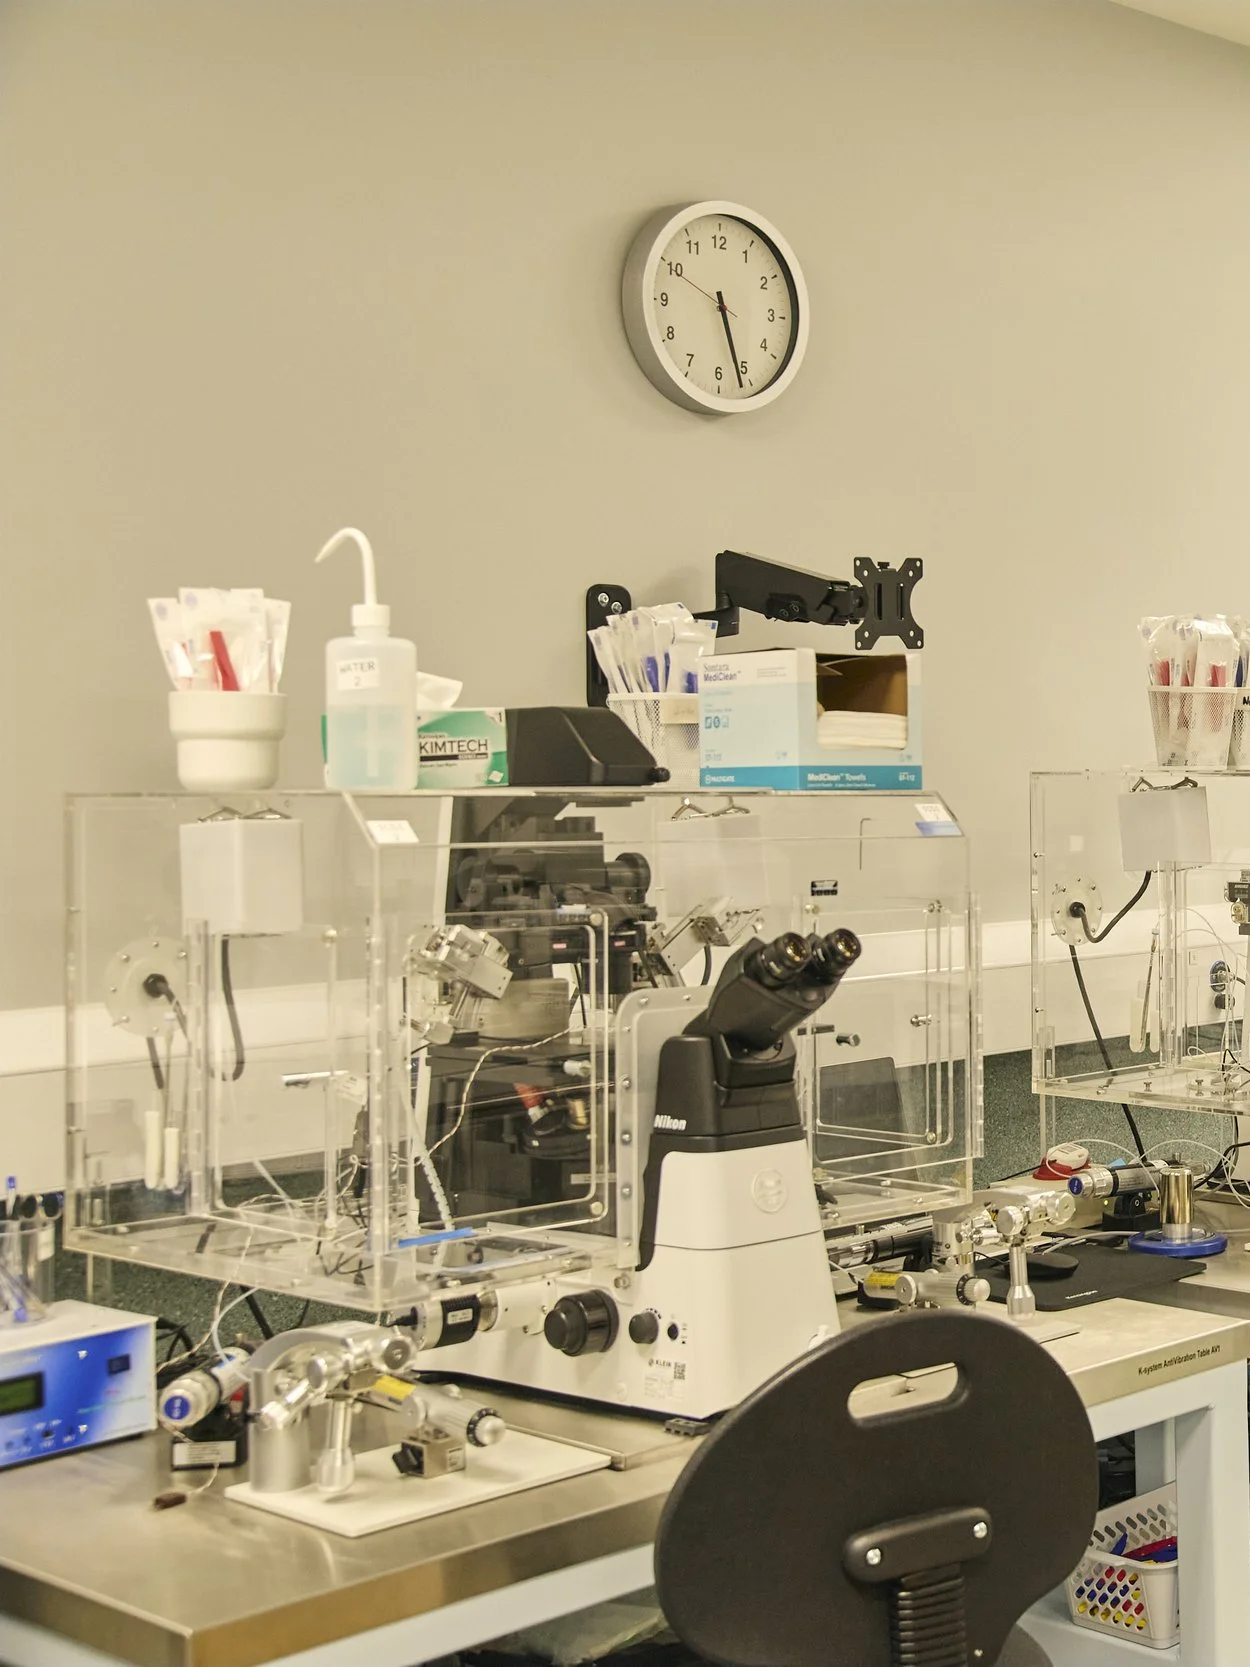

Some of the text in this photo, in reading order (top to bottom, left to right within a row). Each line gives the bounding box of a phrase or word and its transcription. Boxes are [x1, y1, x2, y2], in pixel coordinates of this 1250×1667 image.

[686, 240, 699, 255] 11
[711, 235, 727, 250] 12
[742, 250, 748, 263] 1
[667, 262, 683, 277] 10
[760, 277, 768, 290] 2
[660, 293, 668, 306] 9
[768, 309, 775, 322] 3
[666, 326, 675, 340] 8
[760, 338, 768, 351] 4
[686, 353, 694, 367] 7
[715, 367, 723, 380] 6
[740, 361, 748, 374] 5
[419, 739, 488, 754] KIMTECH
[653, 1114, 687, 1131] Nikon
[1138, 1362, 1163, 1376] K-system
[1163, 1352, 1197, 1368] AntiVibration
[1197, 1348, 1211, 1359] Table
